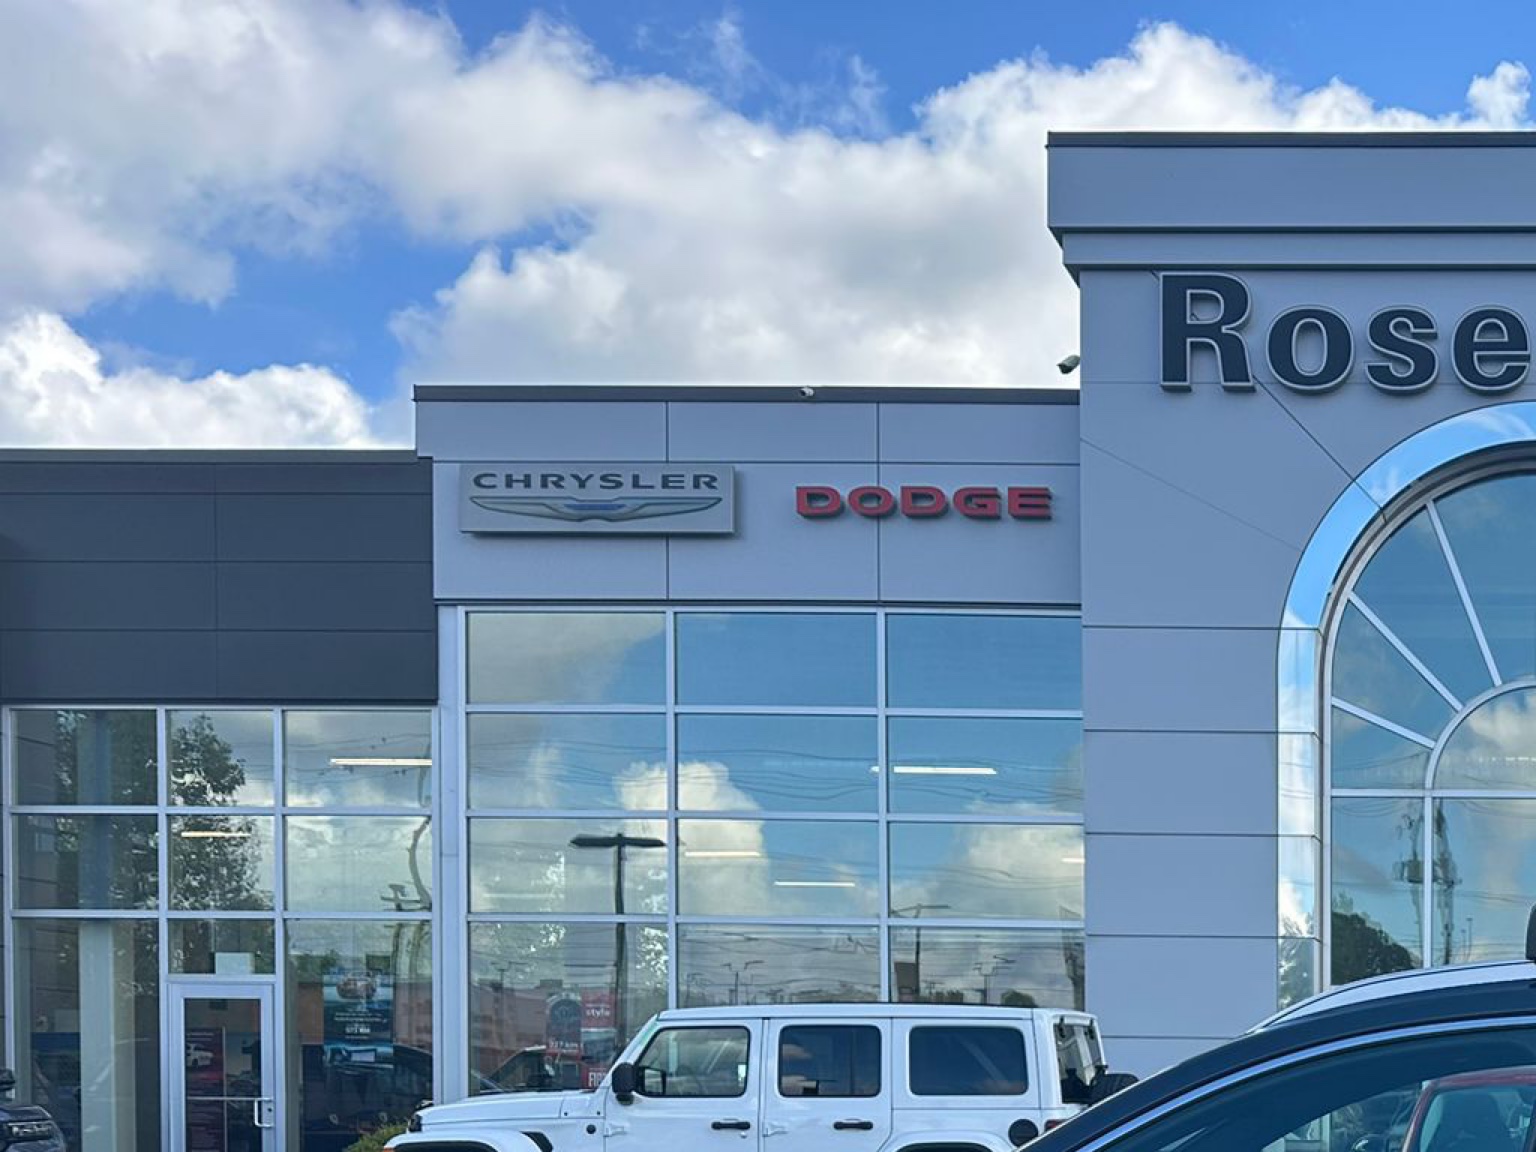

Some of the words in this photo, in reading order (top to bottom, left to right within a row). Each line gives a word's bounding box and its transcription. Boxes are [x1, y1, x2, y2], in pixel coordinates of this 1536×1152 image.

[1160, 271, 1531, 393] Rose
[472, 473, 719, 490] CHRYSLER
[796, 486, 1054, 519] DODGE
